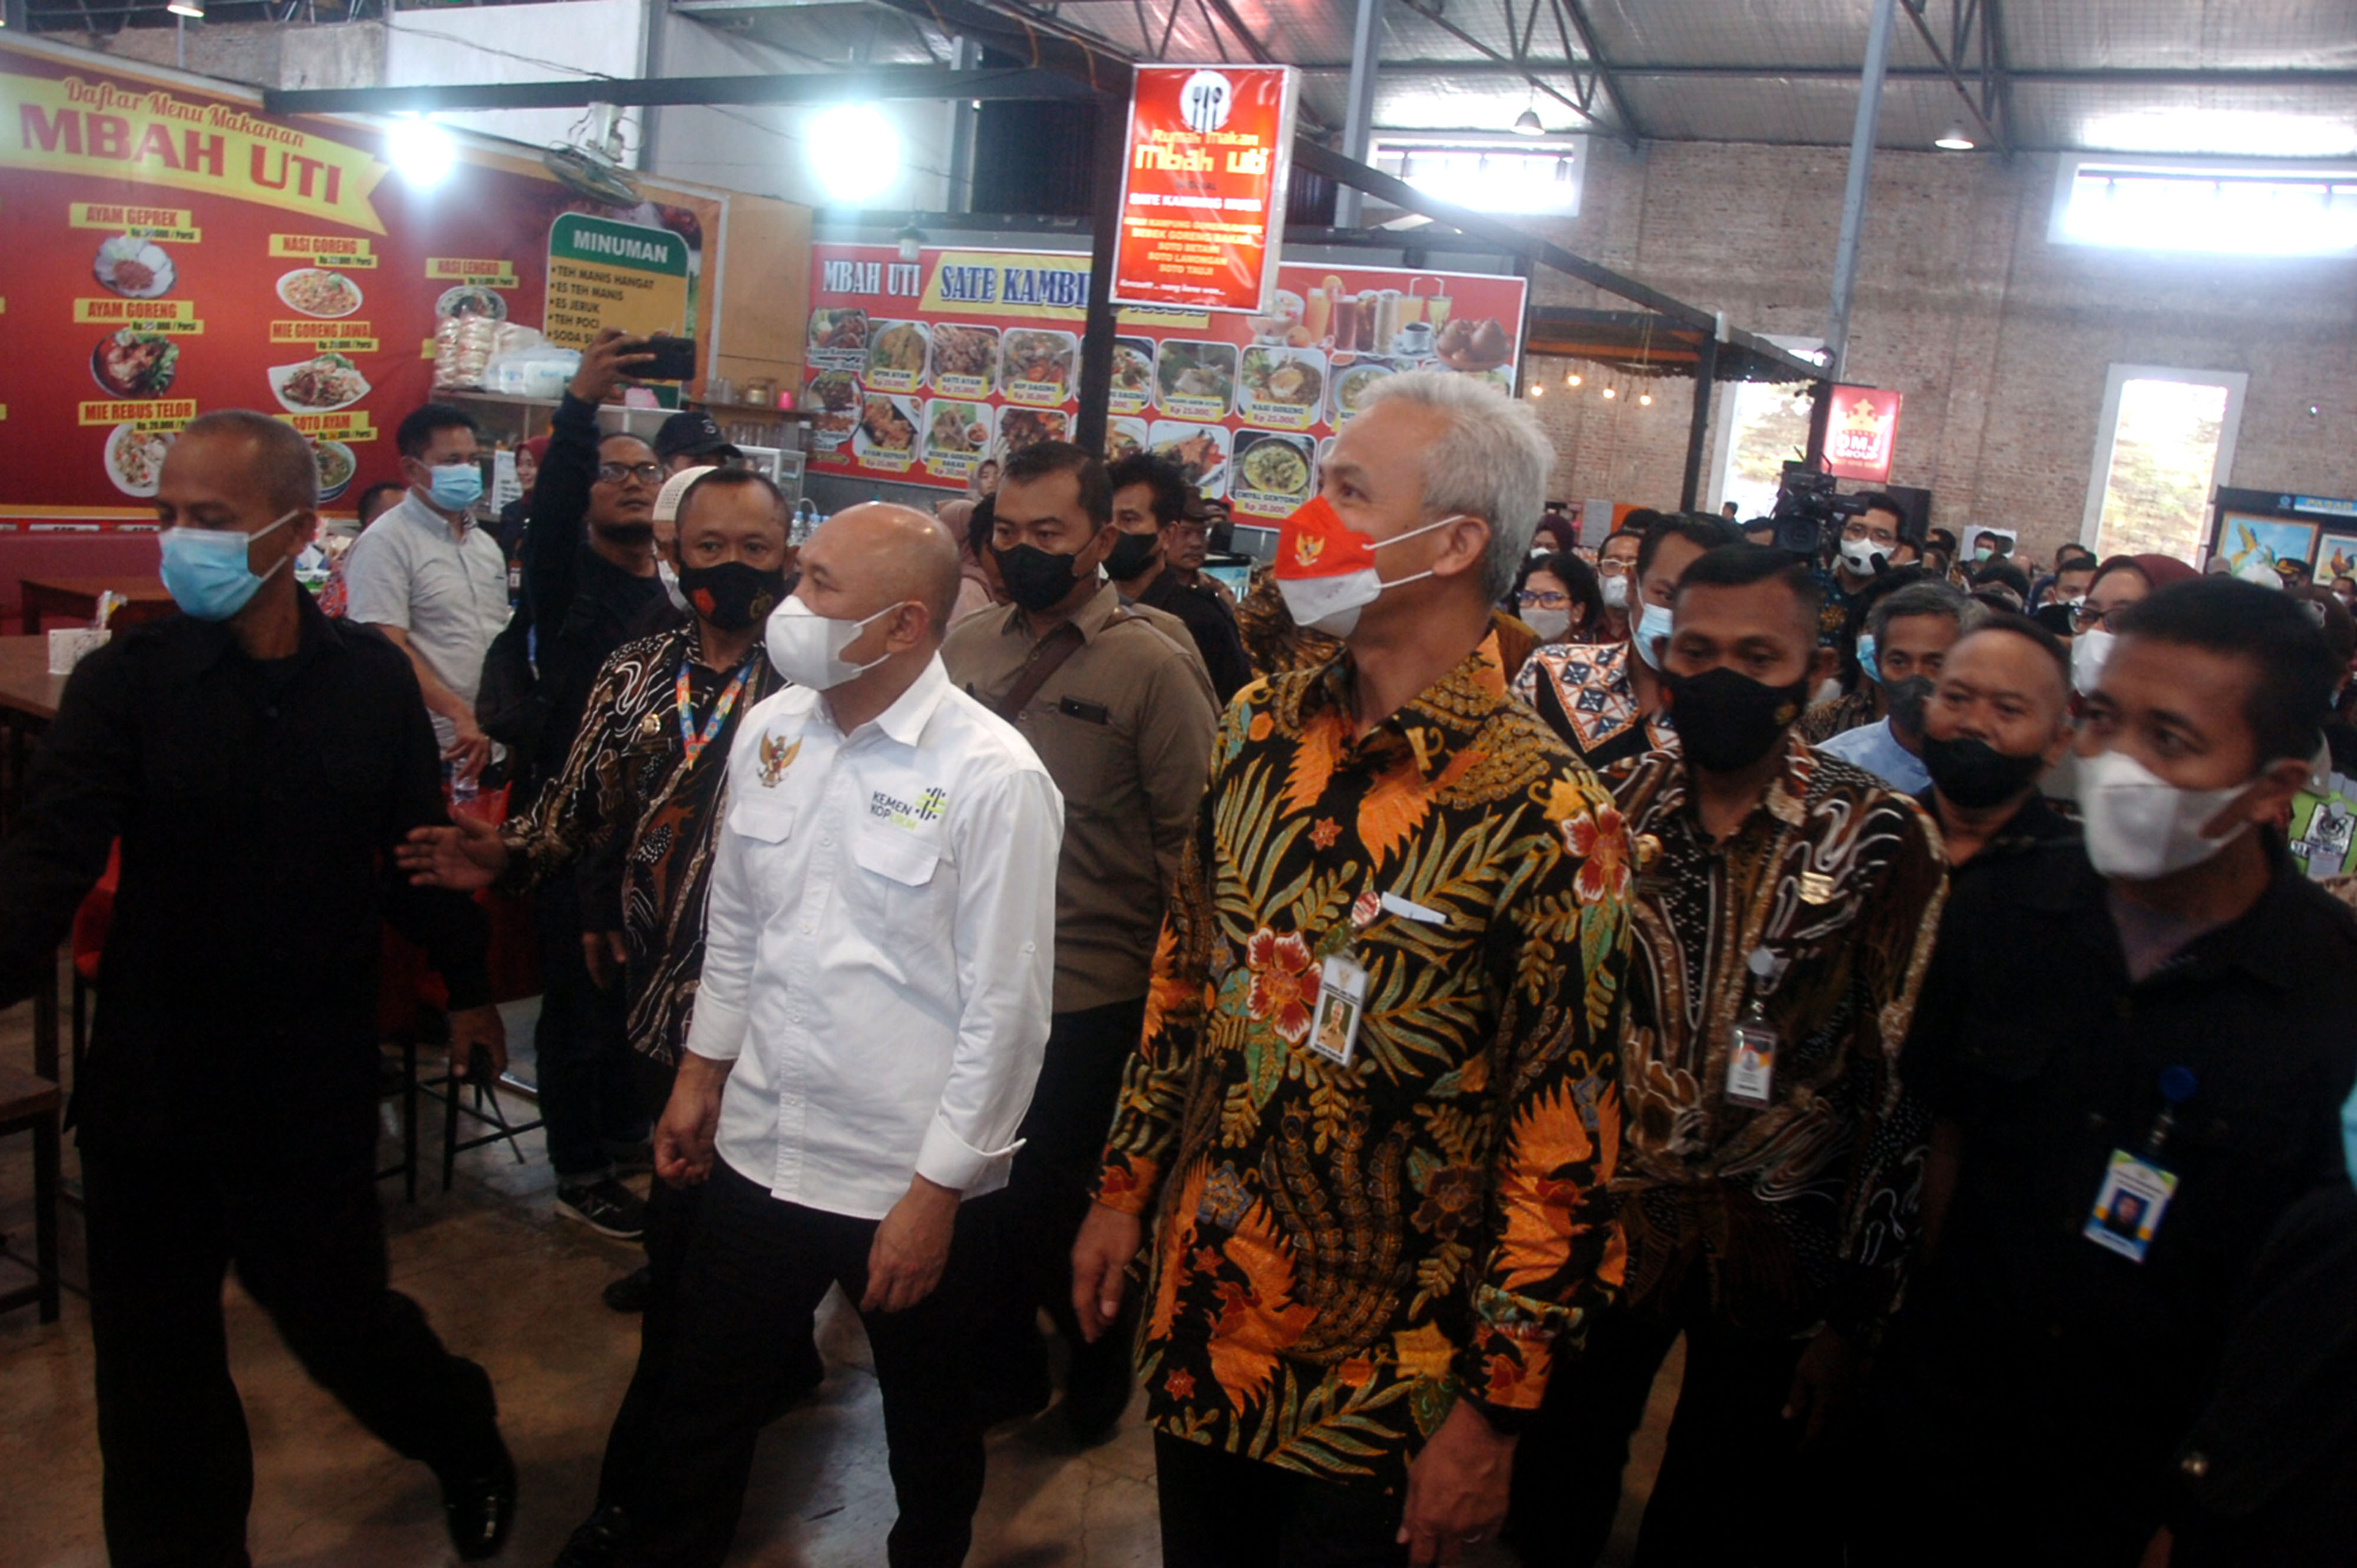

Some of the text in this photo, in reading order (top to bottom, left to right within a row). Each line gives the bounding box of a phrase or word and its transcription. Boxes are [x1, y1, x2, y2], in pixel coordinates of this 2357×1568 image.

[65, 77, 305, 148] Daftar Menu Makanan
[19, 103, 342, 205] MBAH UTI
[87, 206, 177, 227] AYAM GEPREK
[283, 237, 357, 254] NASI GORENG
[573, 230, 668, 264] MINUMAN
[1158, 242, 1183, 252] SOTO
[1148, 252, 1173, 262] SOTO
[438, 260, 461, 273] NASI
[1159, 263, 1185, 274] SOTO
[558, 266, 655, 289] TEH MANIS HANGAT
[823, 261, 921, 296] MBAH UTI
[556, 282, 623, 301] ES TEH MANIS
[940, 265, 996, 303] SATE
[1002, 268, 1091, 308] KAMBI
[88, 302, 177, 319] AYAM GORENG
[556, 298, 600, 313] ES JERUK
[554, 313, 599, 329] TEH POCI
[273, 323, 370, 338] MIE GORENG JAWA
[553, 330, 581, 342] SODA
[85, 402, 192, 420] MIE REBUS TELOR
[1252, 403, 1305, 415] NASI GORENG
[293, 414, 351, 431] SOTO AYAM
[1253, 414, 1265, 424] Rp
[873, 791, 913, 817] KEMEN
